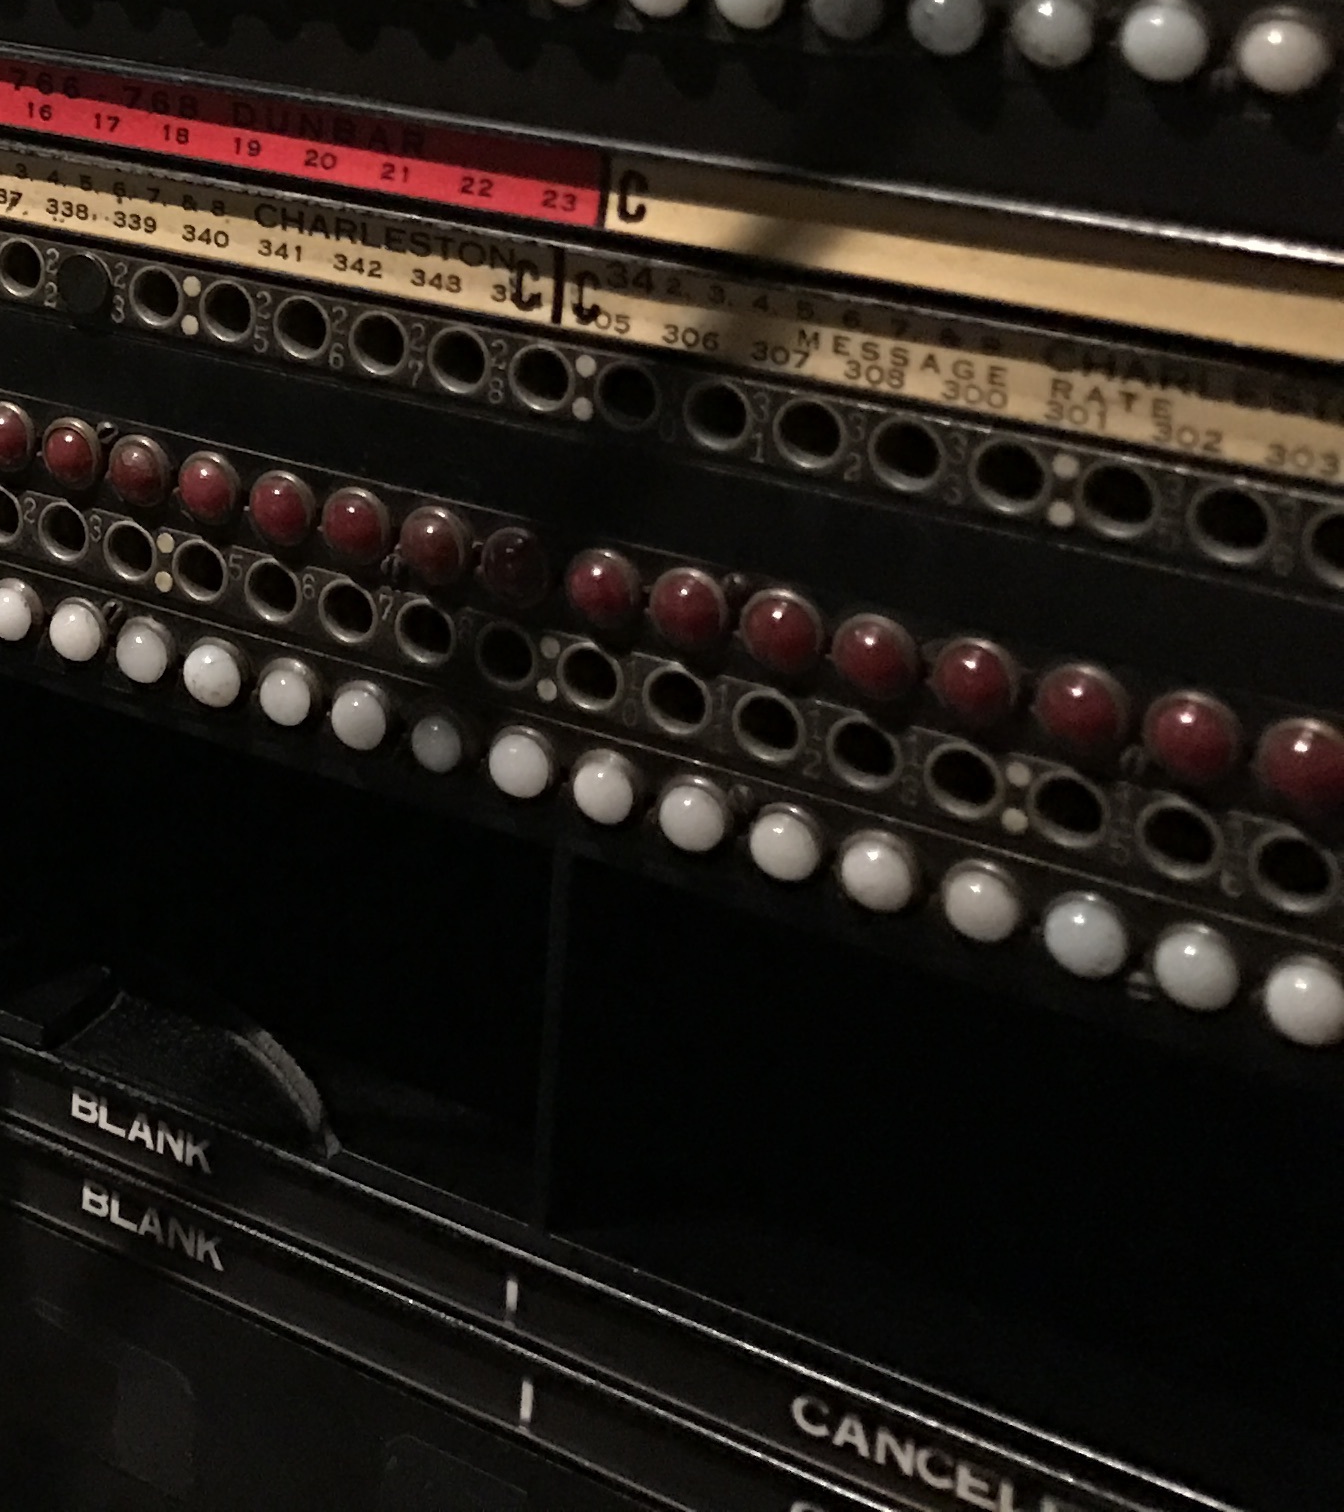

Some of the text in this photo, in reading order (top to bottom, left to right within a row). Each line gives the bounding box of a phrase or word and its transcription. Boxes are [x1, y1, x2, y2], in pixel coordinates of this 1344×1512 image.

[28, 101, 52, 121] 16
[94, 112, 120, 133] 17
[163, 124, 190, 144] 18
[233, 137, 262, 157] 19
[304, 148, 338, 170] 20
[380, 163, 410, 184] 21
[459, 176, 494, 198] 22
[542, 189, 577, 212] 23
[232, 103, 427, 155] DUNBAR
[253, 203, 515, 270] CHARLESTON
[617, 170, 649, 223] C
[45, 198, 89, 221] 338
[112, 211, 157, 233] 339
[181, 224, 229, 248] 340
[258, 239, 303, 263] 341
[333, 254, 383, 279] 342
[410, 268, 463, 293] 343
[511, 259, 542, 312] C
[573, 262, 653, 324] C 34
[662, 323, 1341, 476] 306 307 308 300 301 302 303
[797, 328, 1008, 387] MESSAGE
[1050, 378, 1172, 420] RATE
[70, 1086, 212, 1175] BLANK
[81, 1183, 224, 1273] BLANK
[789, 1394, 1068, 1512] CANCEL
